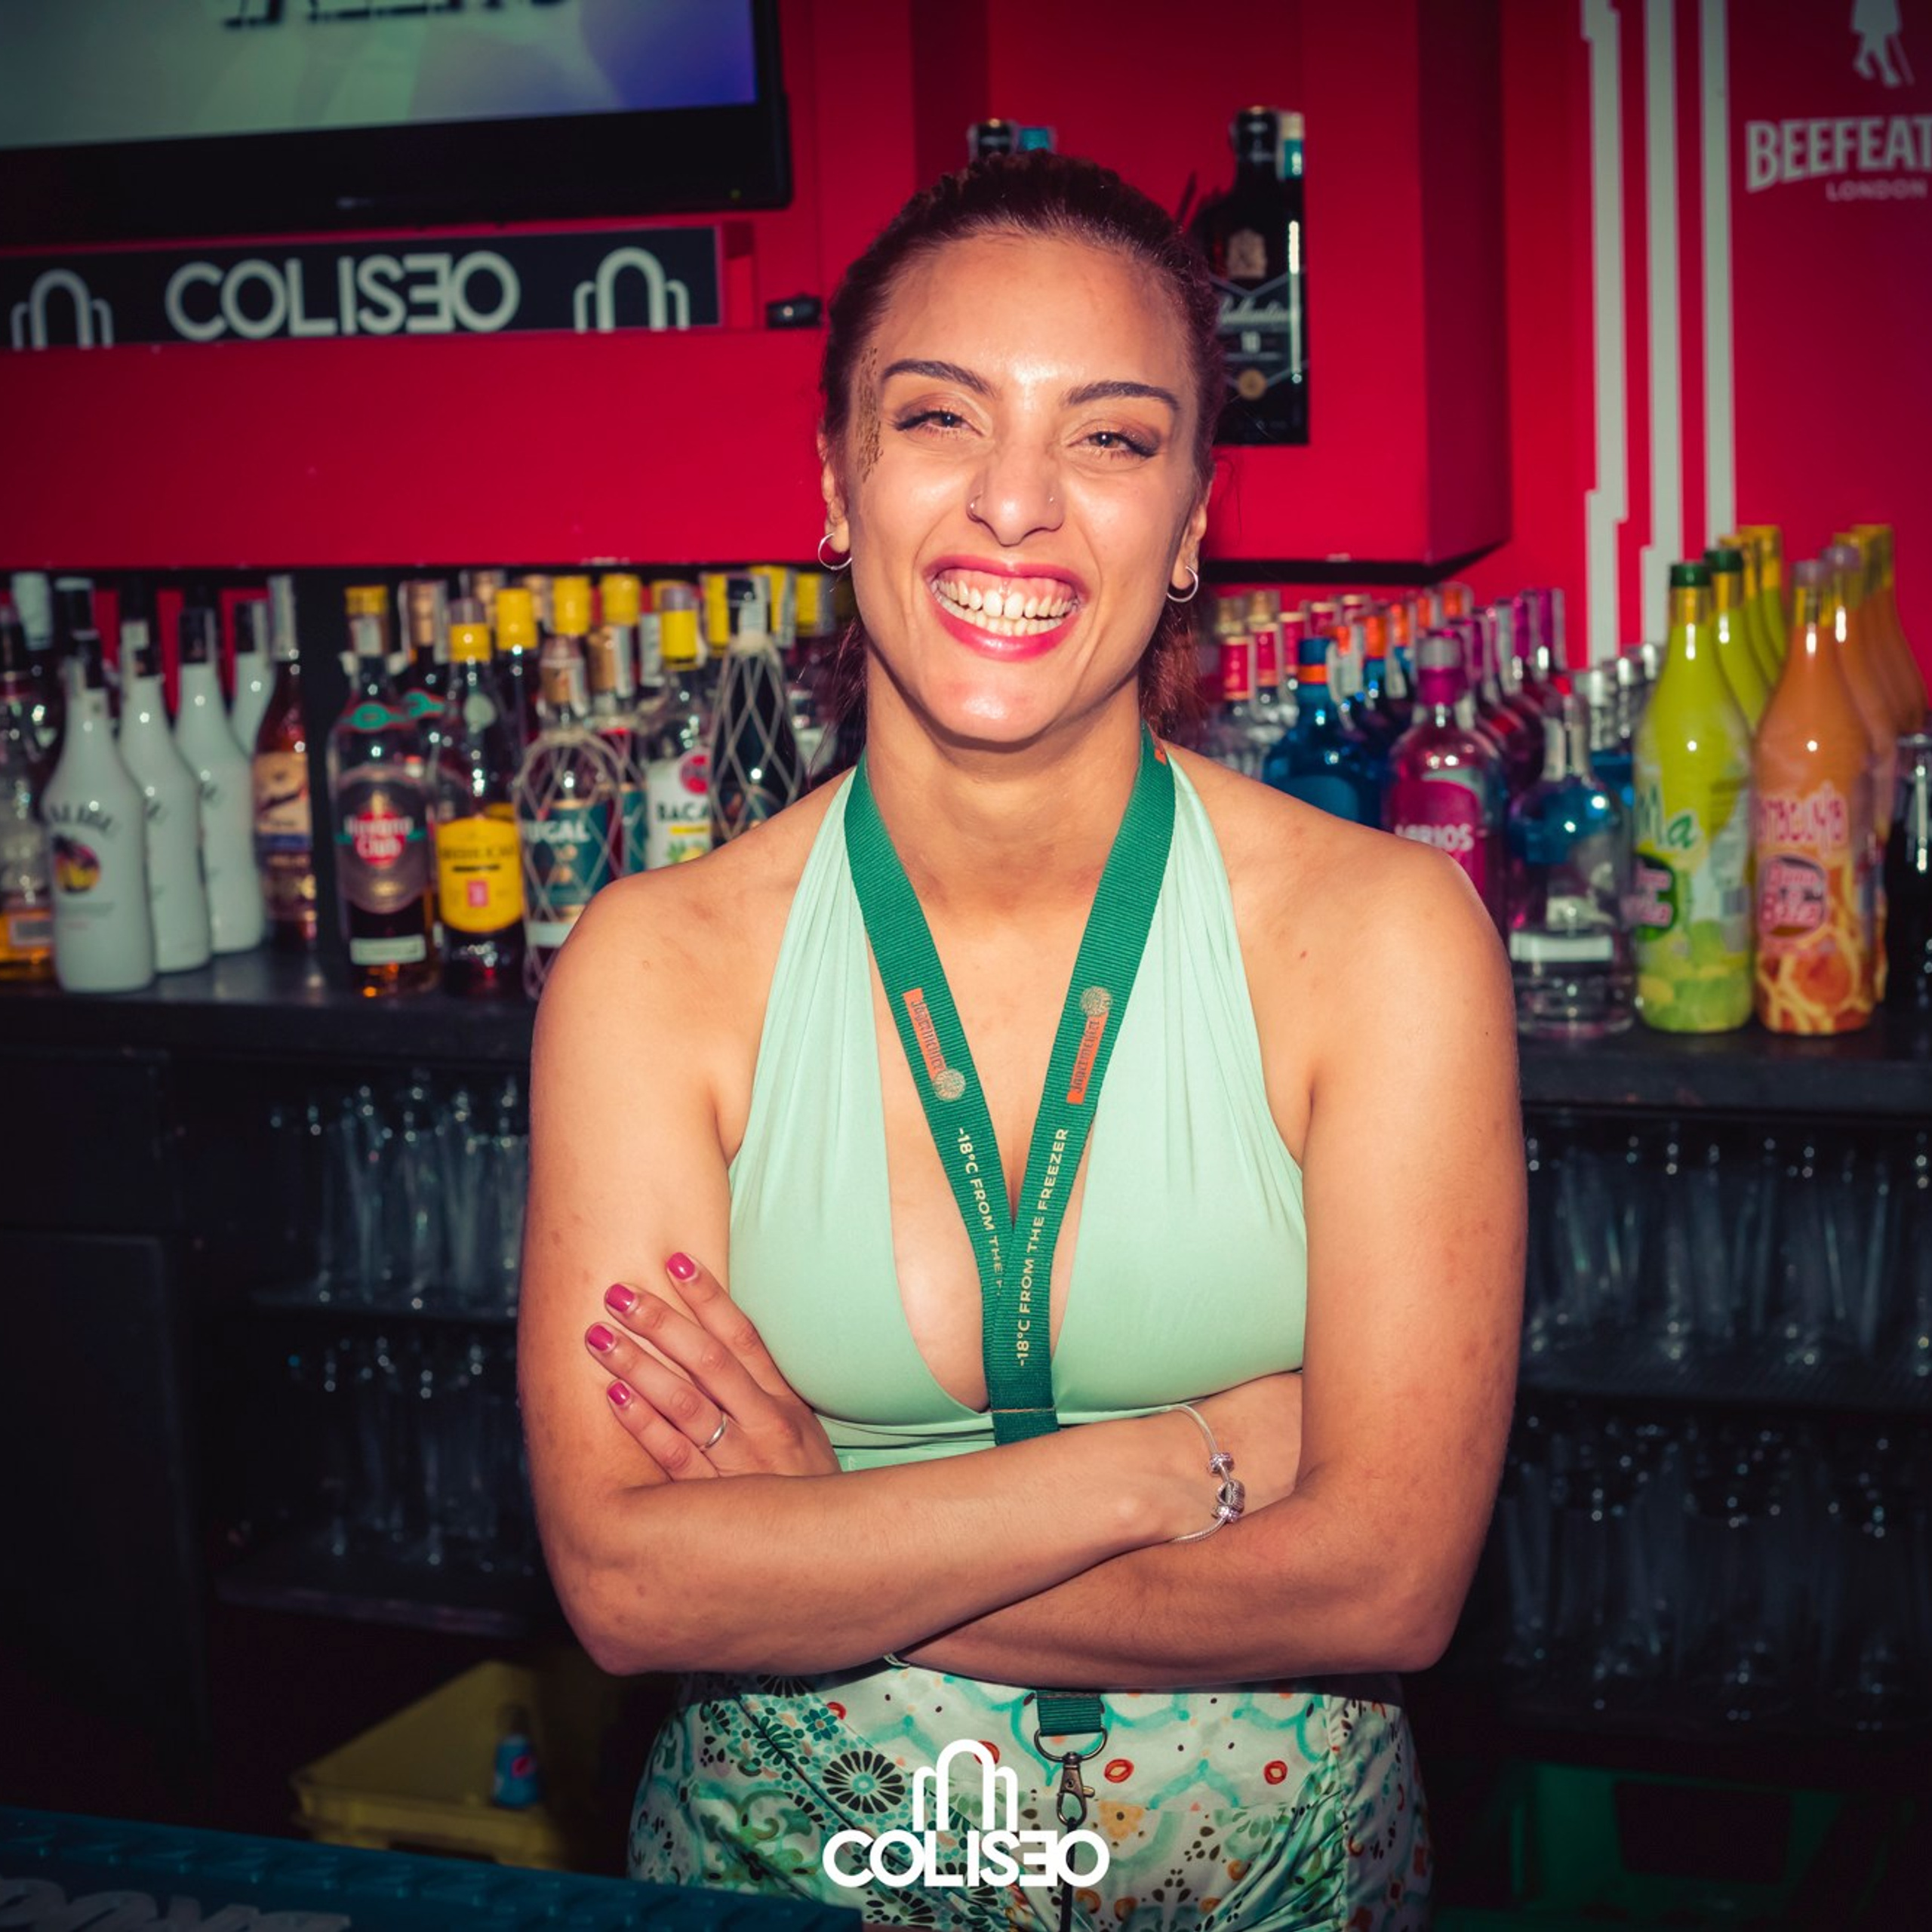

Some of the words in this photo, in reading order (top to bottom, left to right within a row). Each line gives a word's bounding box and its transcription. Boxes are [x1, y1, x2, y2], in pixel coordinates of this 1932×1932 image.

[1826, 178, 1928, 202] LONDON
[165, 250, 520, 342] COLISEO
[1038, 1128, 1069, 1211] FREEZER
[970, 1178, 995, 1232] FROM
[988, 1235, 1004, 1275] THE
[1026, 1216, 1045, 1254] THE
[1019, 1258, 1035, 1314] FROM
